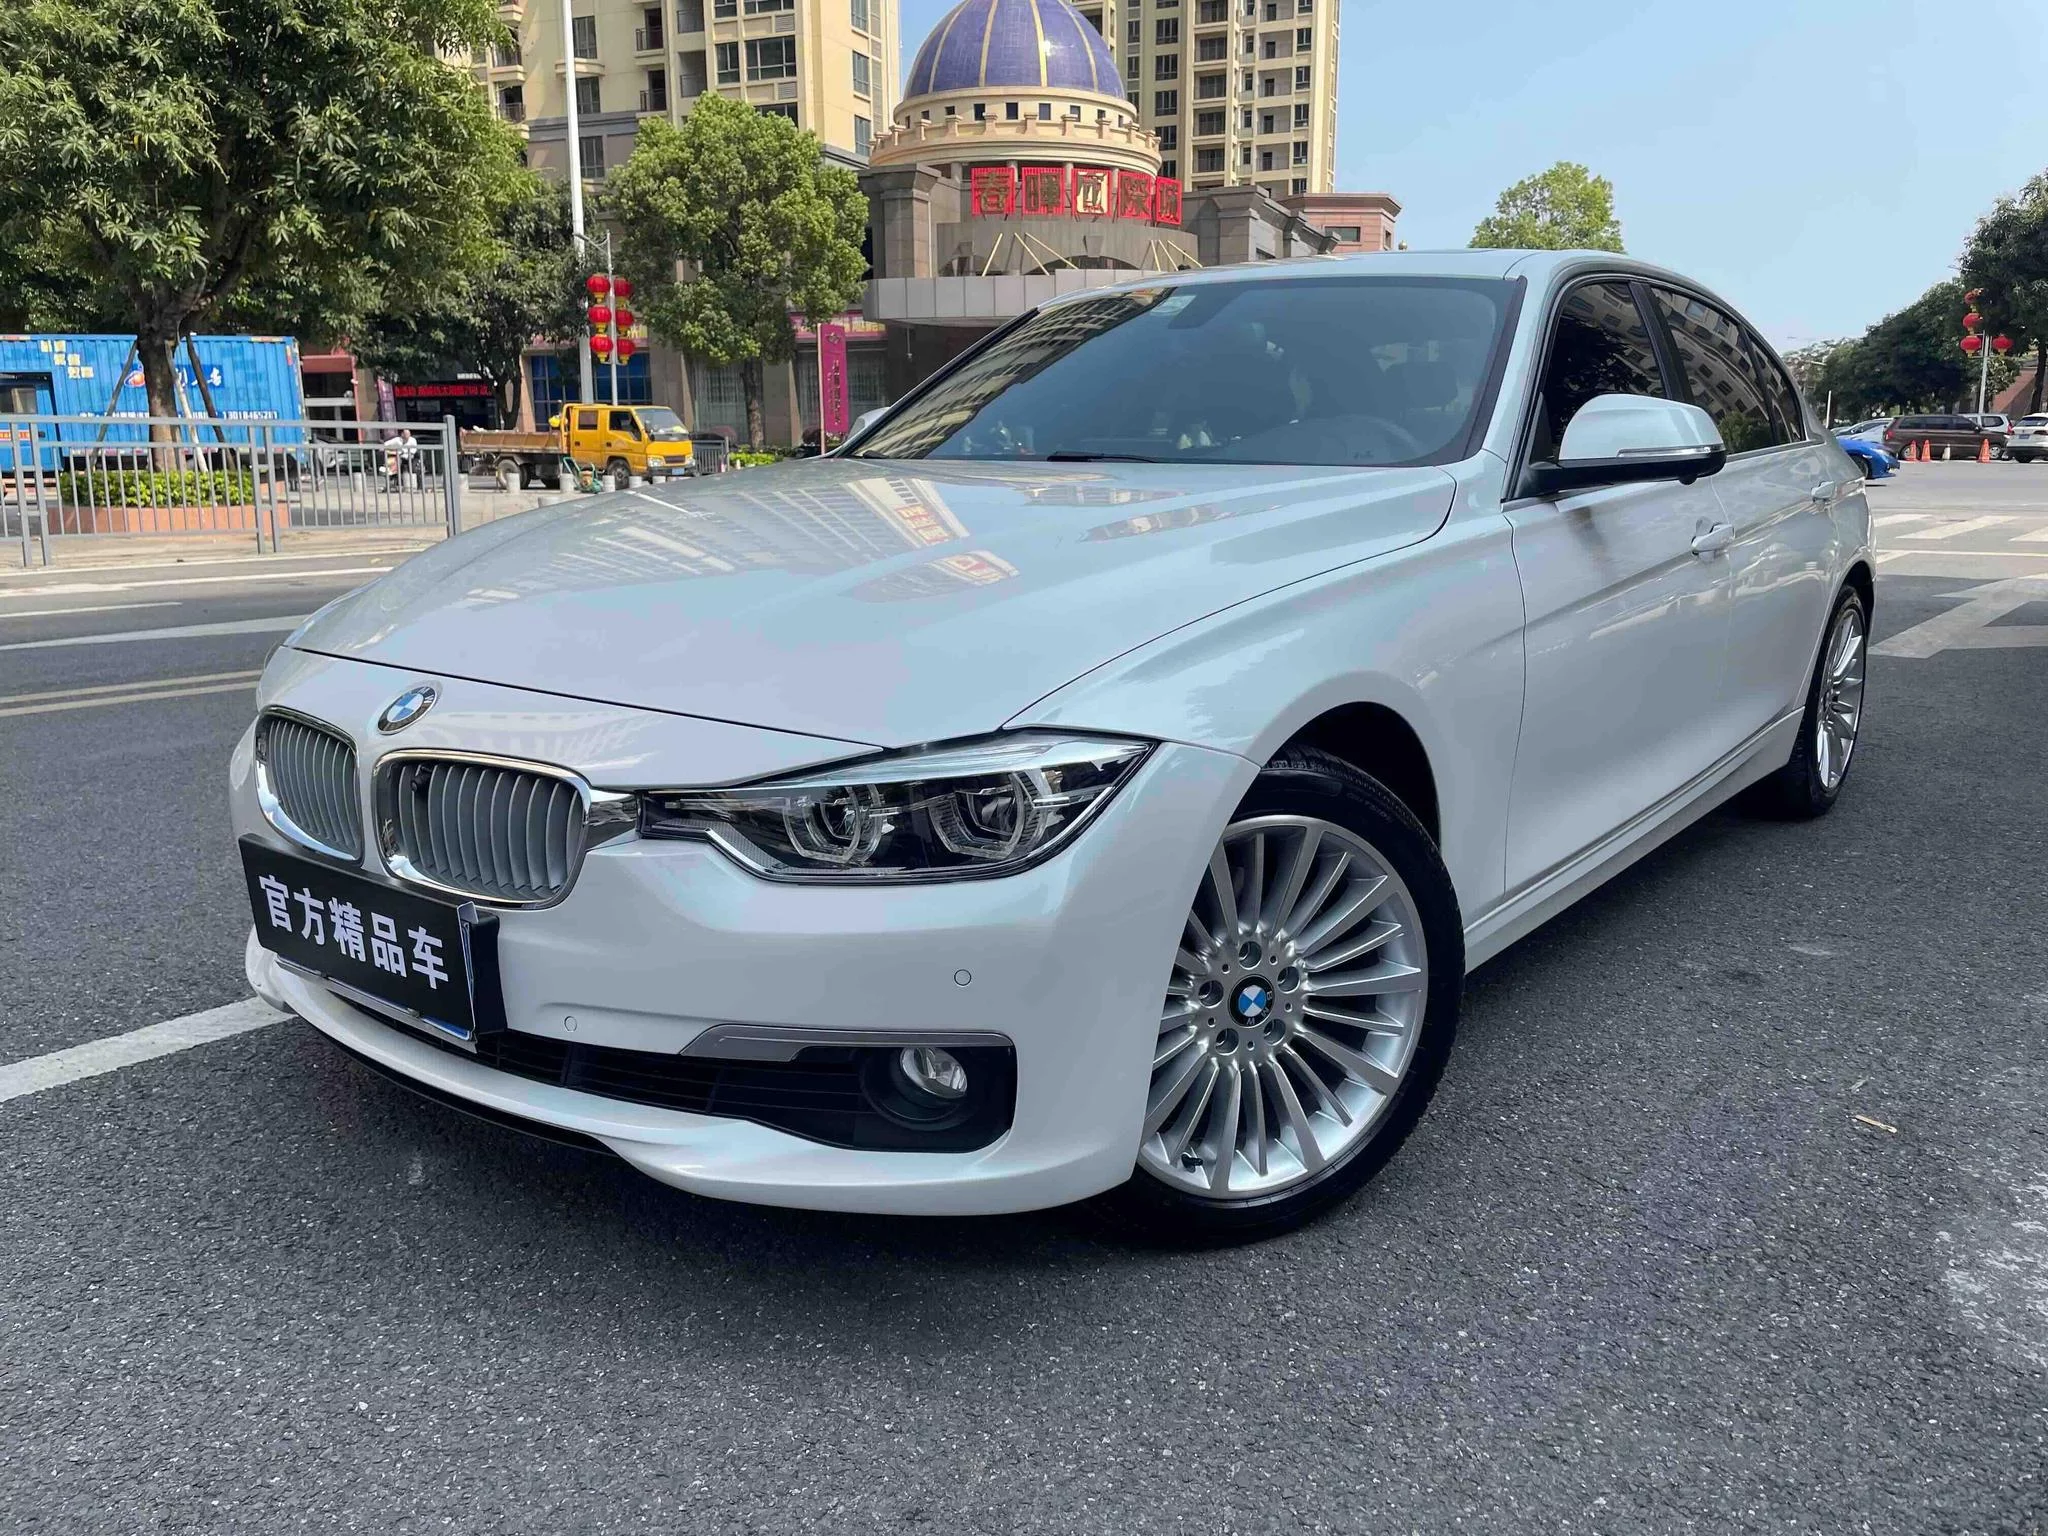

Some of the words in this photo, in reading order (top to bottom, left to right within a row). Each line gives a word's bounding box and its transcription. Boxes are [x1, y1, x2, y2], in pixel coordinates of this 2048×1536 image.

[258, 874, 450, 990] 官方精品车
